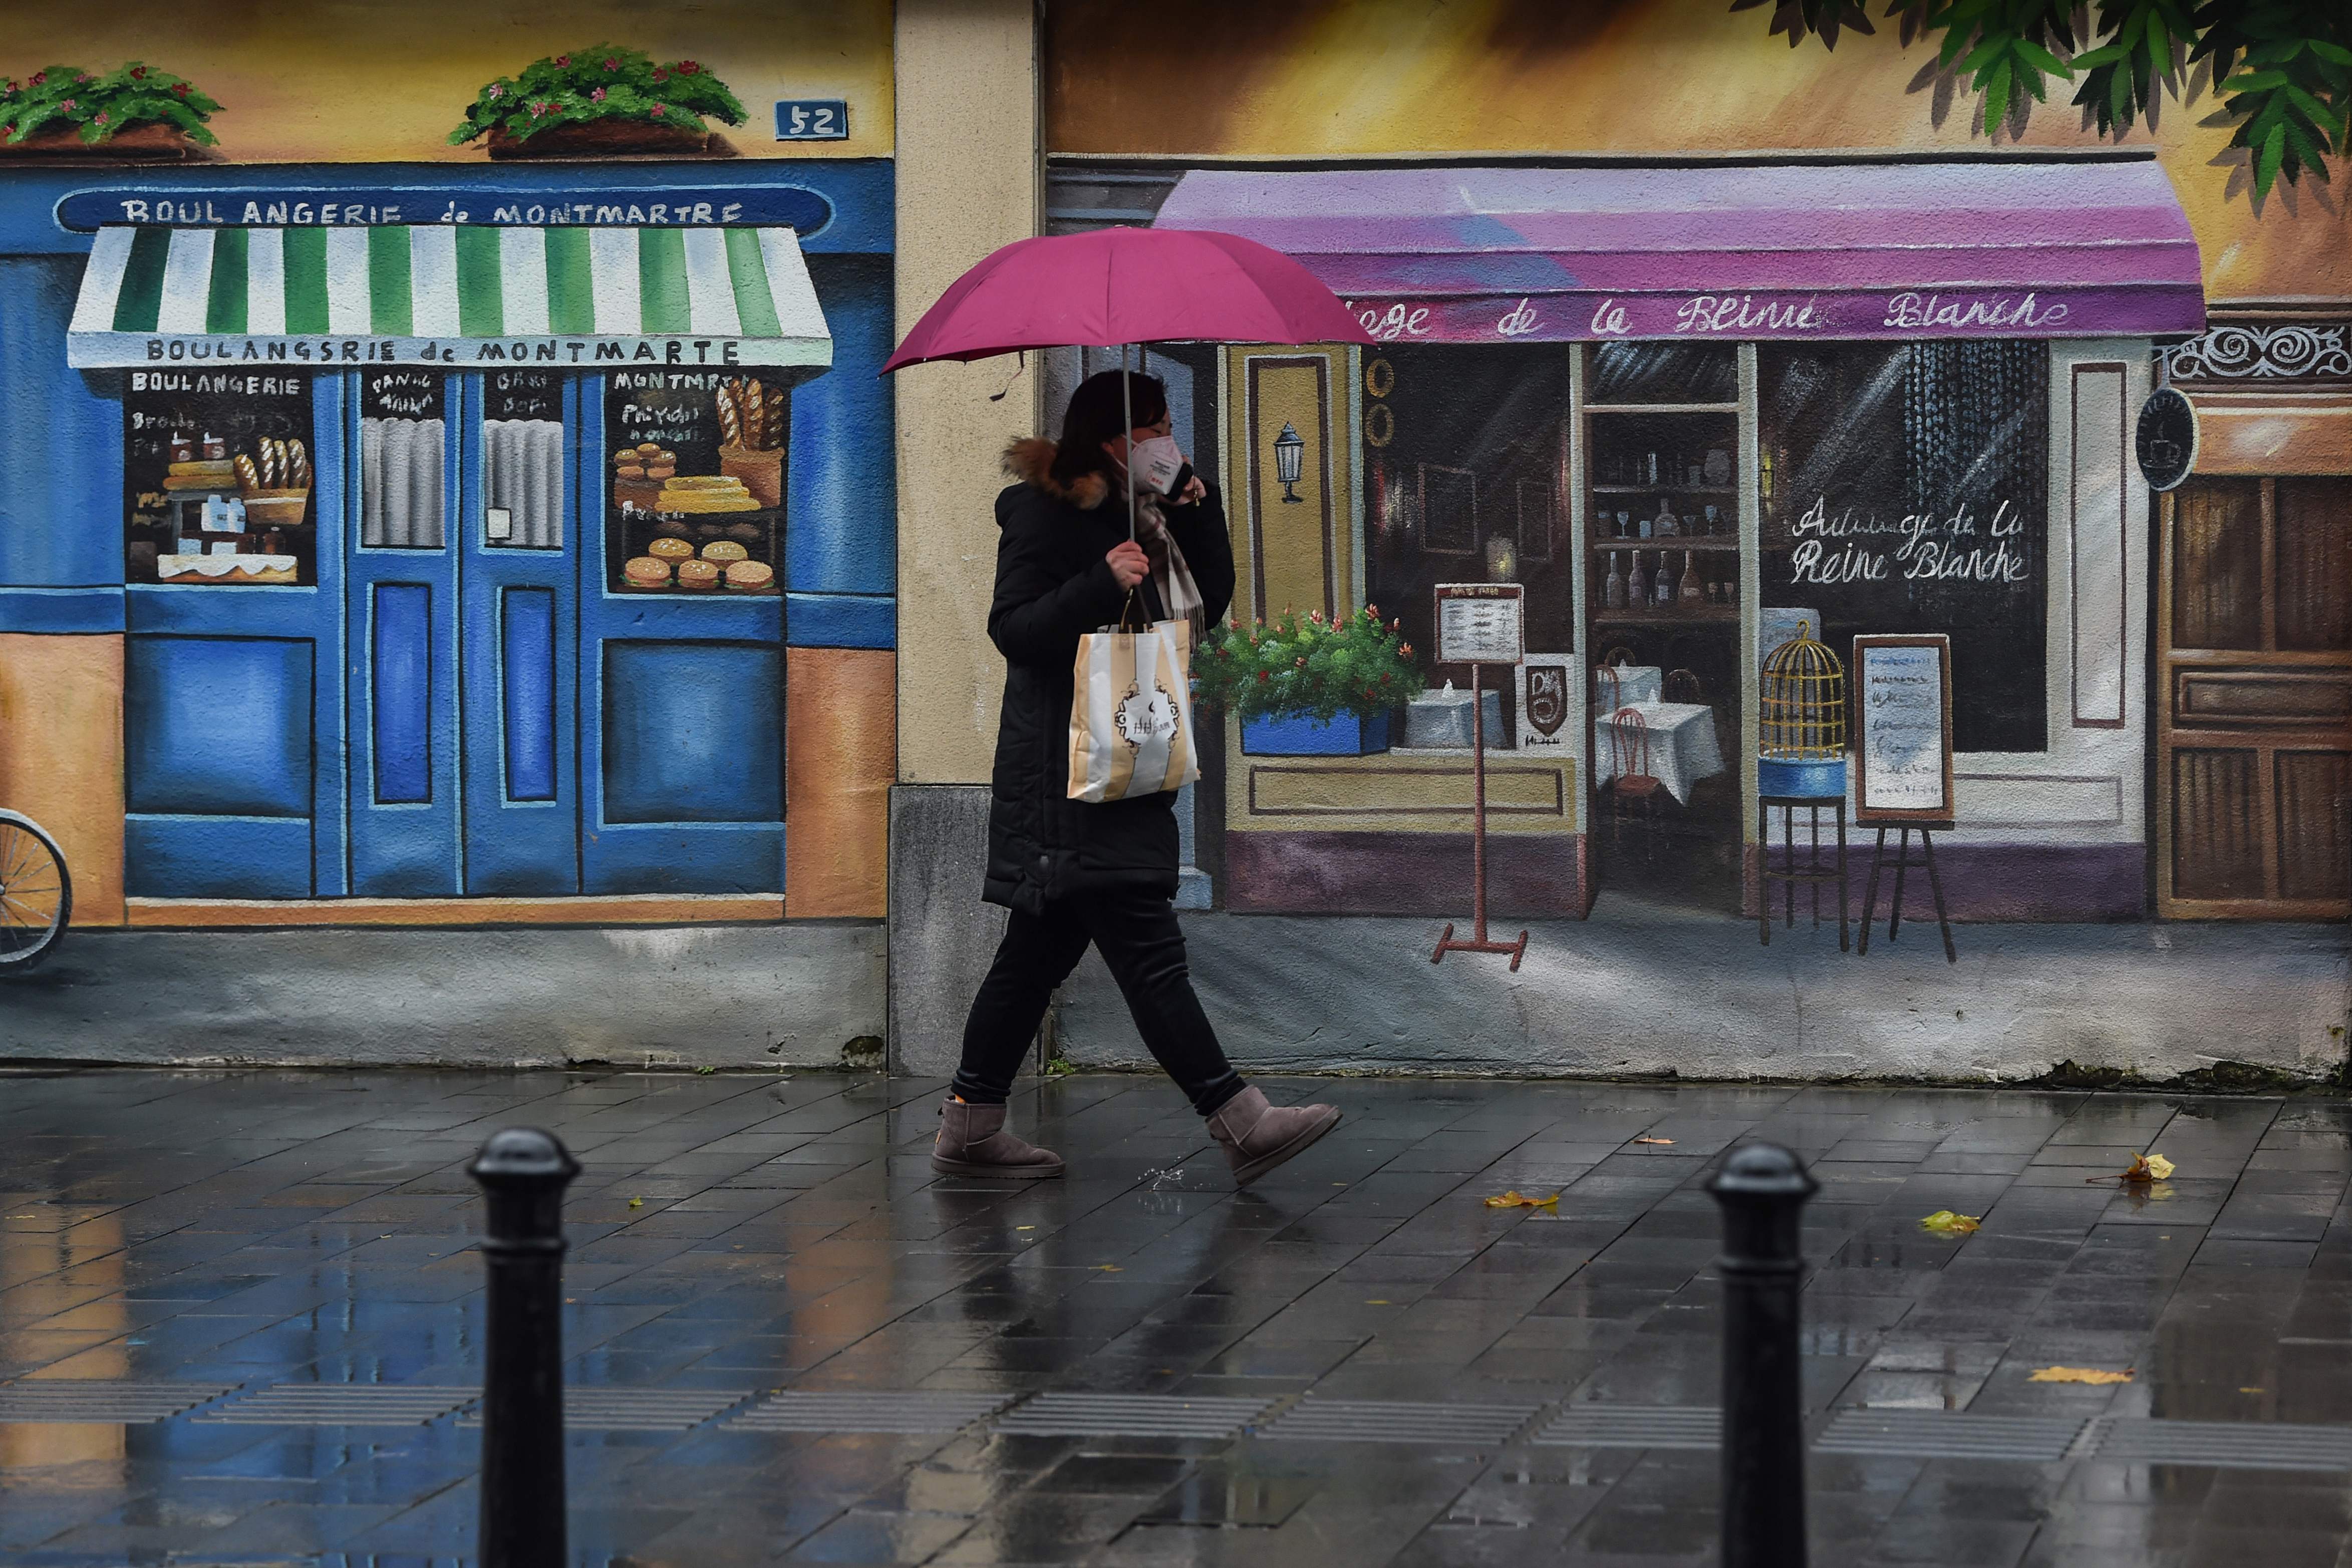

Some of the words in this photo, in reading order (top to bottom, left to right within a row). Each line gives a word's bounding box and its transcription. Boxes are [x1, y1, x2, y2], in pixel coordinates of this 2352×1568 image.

[789, 105, 834, 134] 52
[441, 200, 469, 223] de
[1498, 297, 1546, 336] de
[1591, 298, 1633, 335] la
[1883, 292, 2074, 328] Blanche
[477, 340, 740, 366] MONTMARTE
[132, 372, 302, 395] BOULANGERIE
[1903, 540, 2029, 583] Blanche
